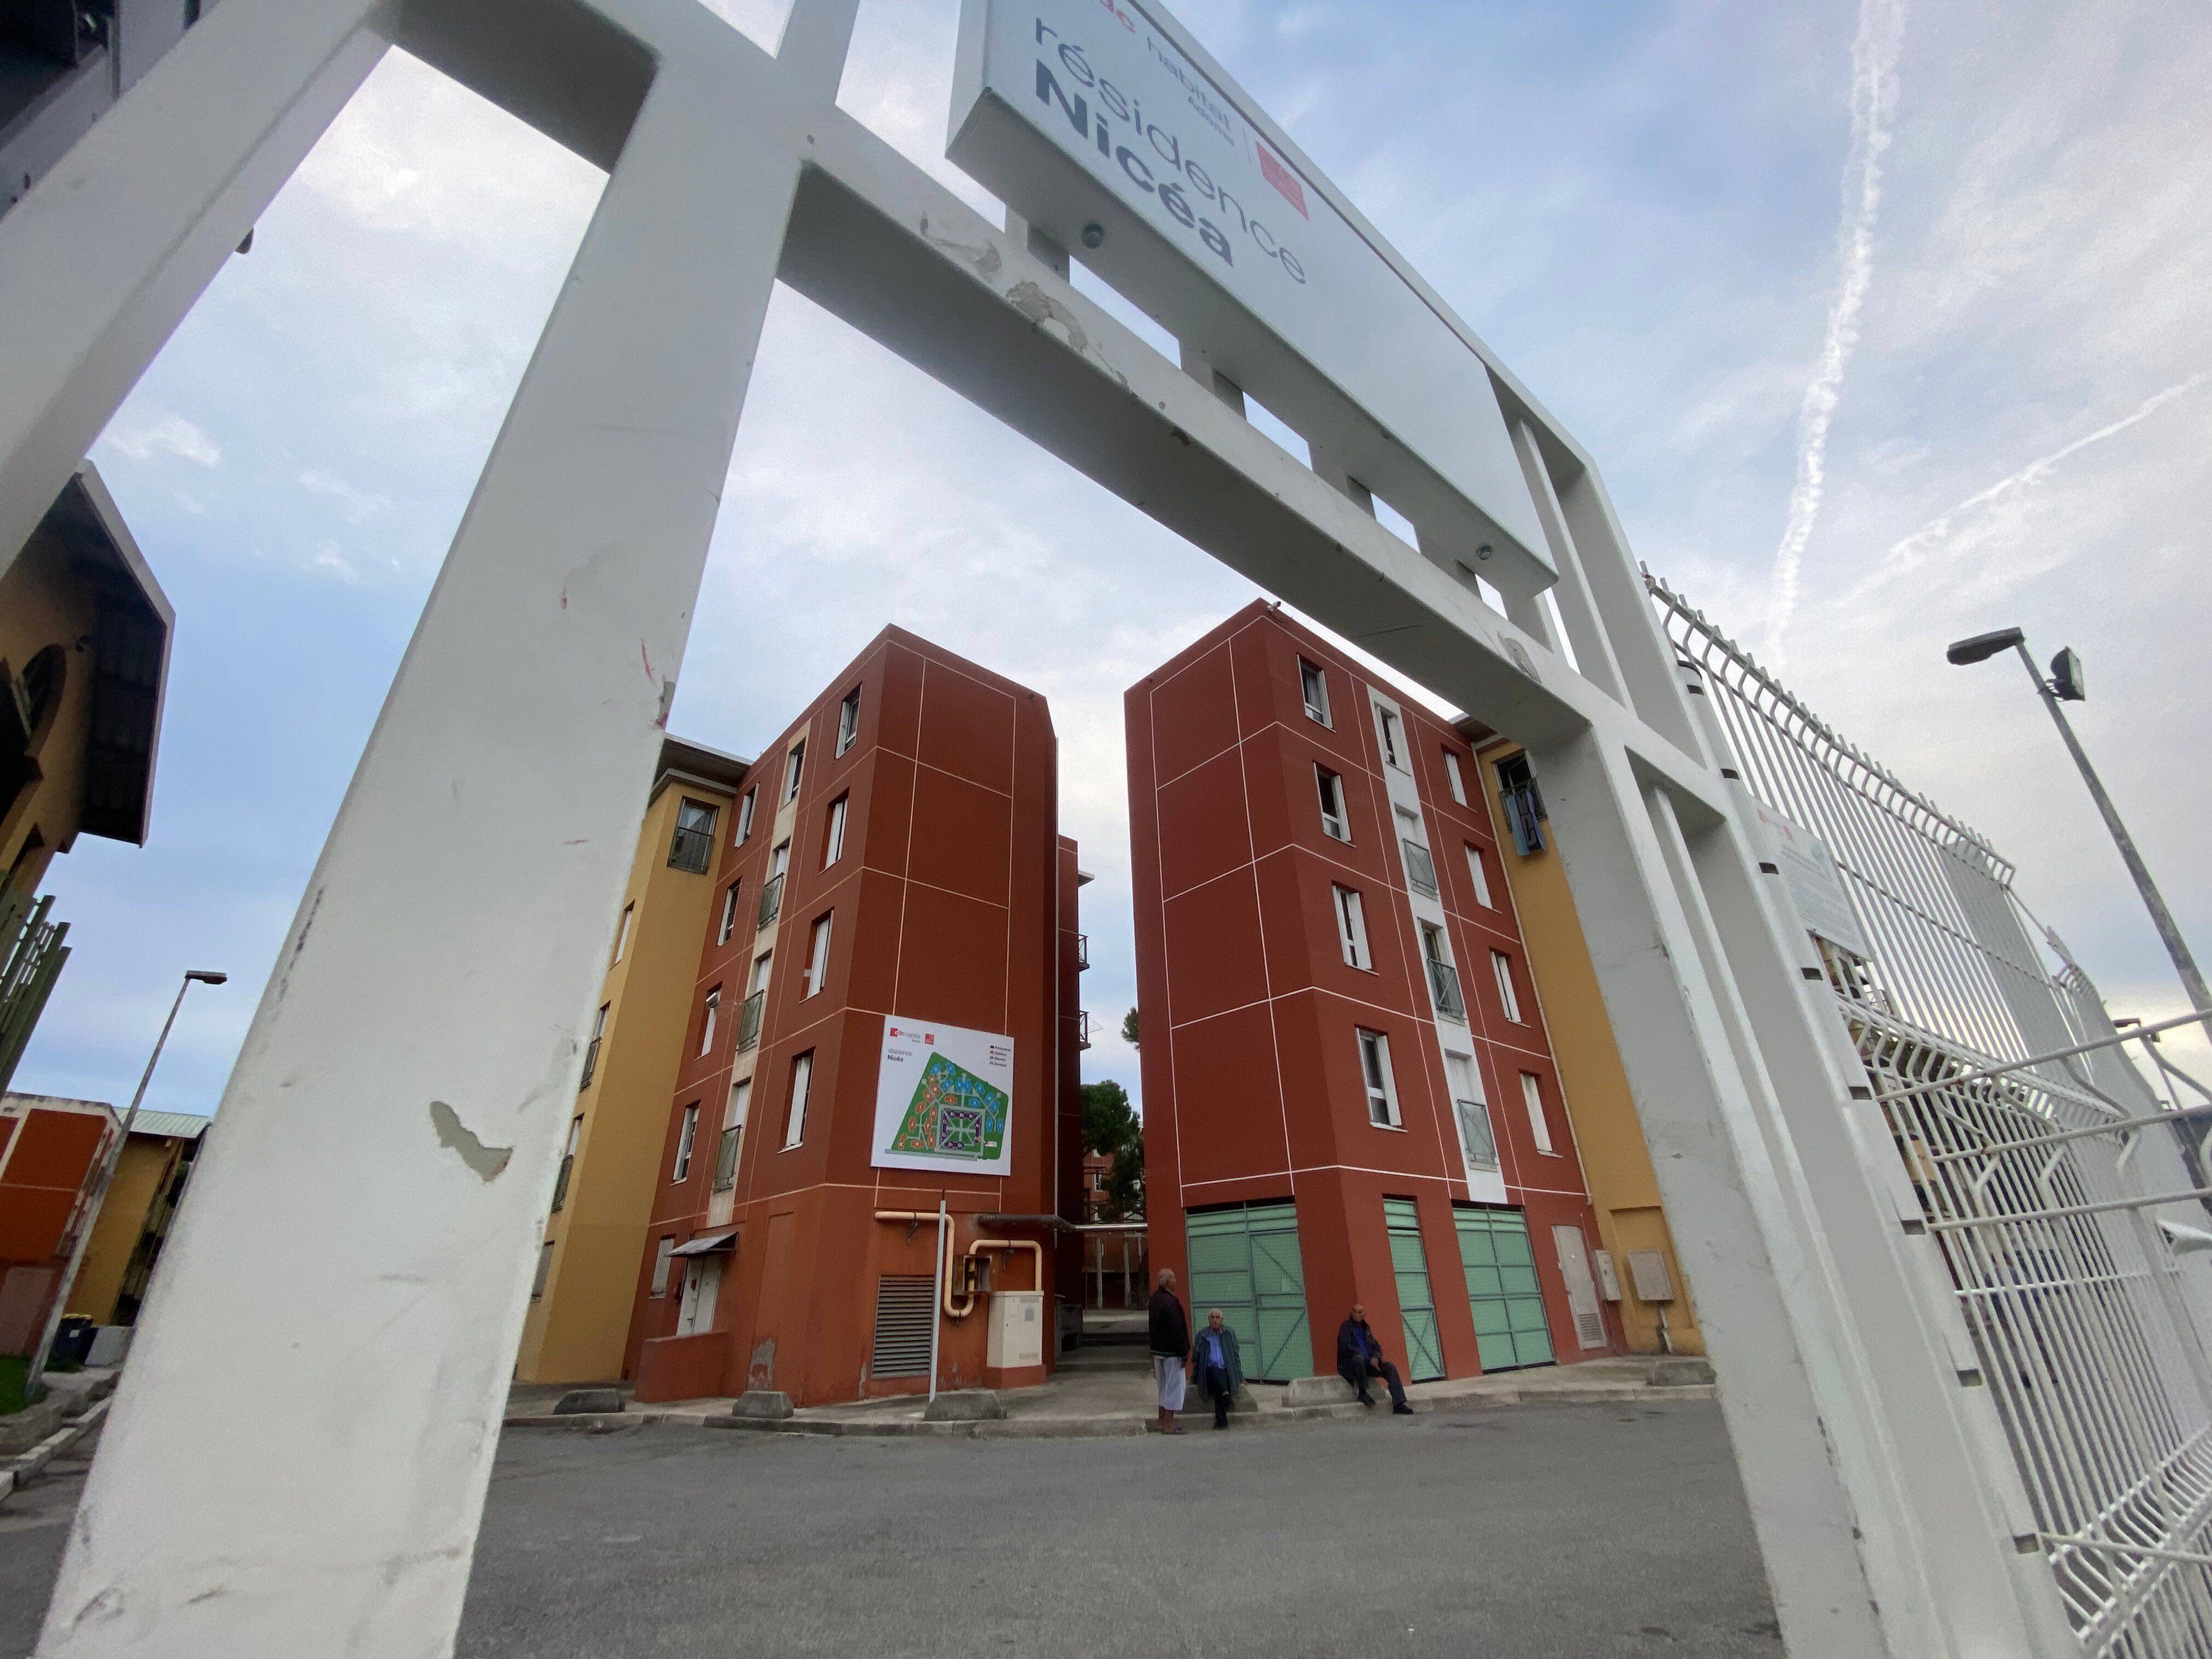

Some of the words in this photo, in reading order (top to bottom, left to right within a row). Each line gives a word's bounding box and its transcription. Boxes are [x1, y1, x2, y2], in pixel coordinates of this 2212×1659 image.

[1035, 17, 1306, 284] résidence
[1035, 59, 1234, 267] Nicéa
[1147, 36, 1231, 132] habitat
